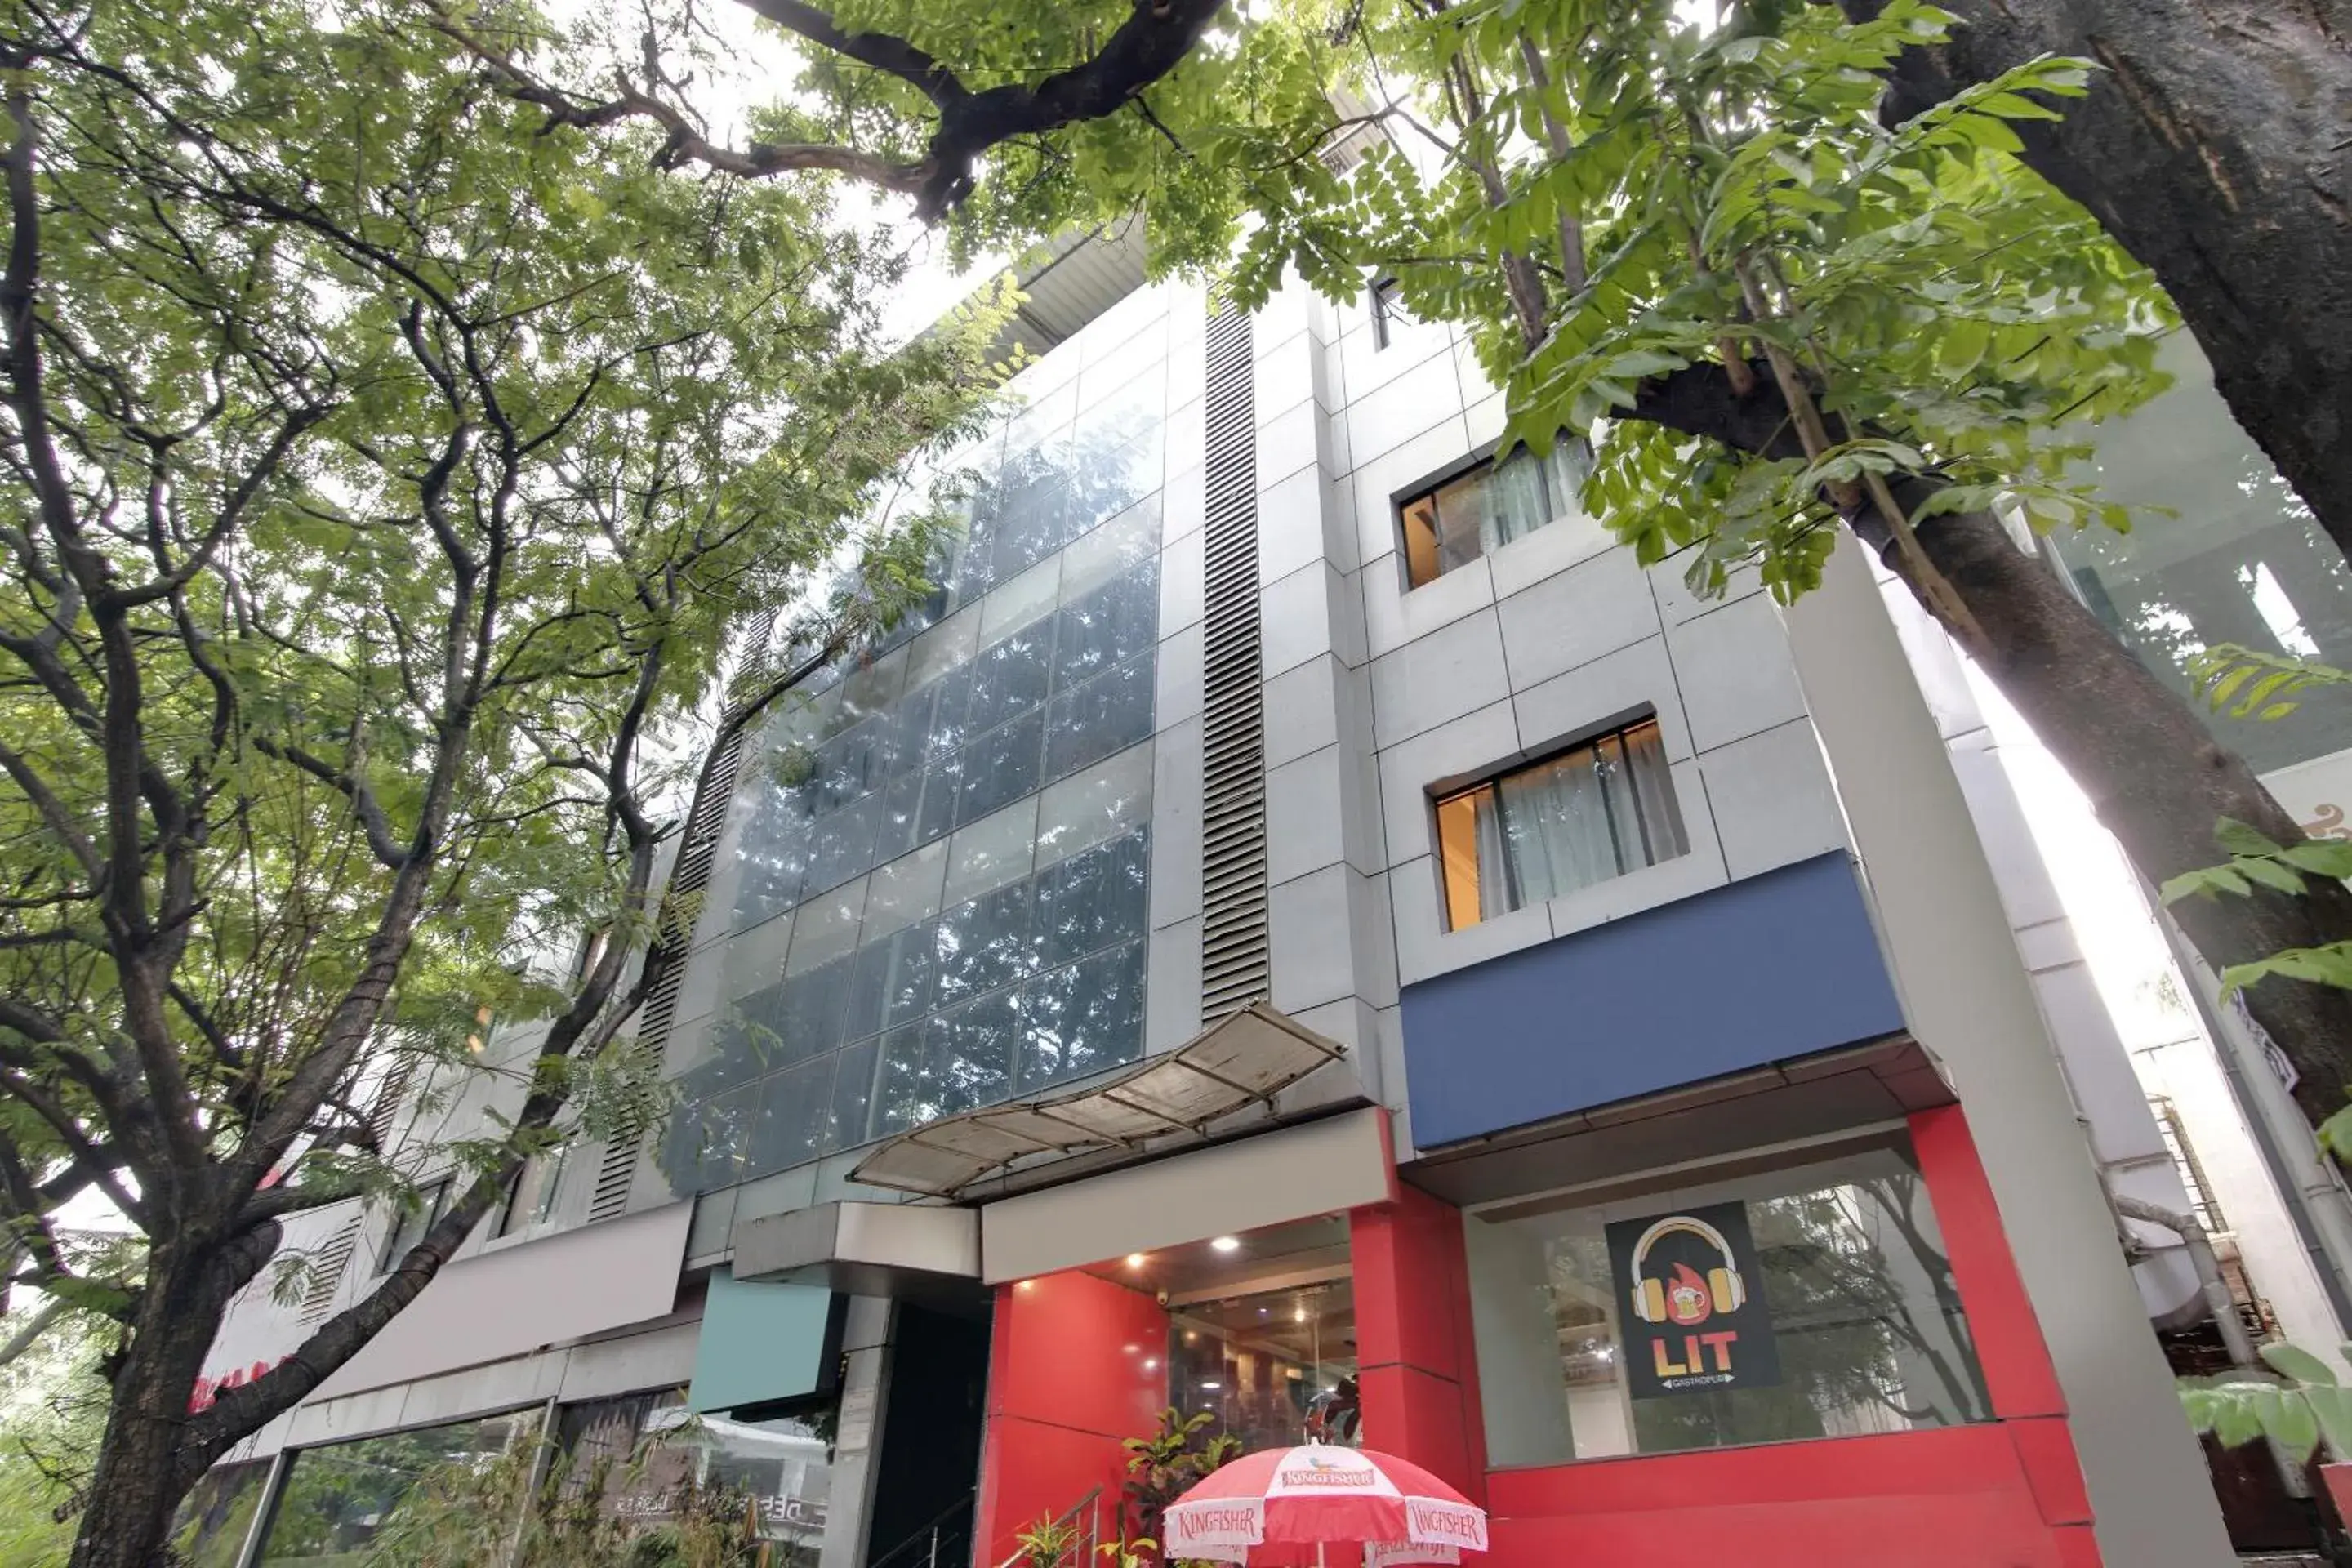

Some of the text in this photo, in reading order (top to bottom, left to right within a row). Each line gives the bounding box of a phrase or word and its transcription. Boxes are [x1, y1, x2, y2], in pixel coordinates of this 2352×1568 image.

[1652, 1331, 1737, 1377] LIT
[1287, 1469, 1374, 1487] KINGFISHER
[1179, 1508, 1255, 1539] KINGFISHER
